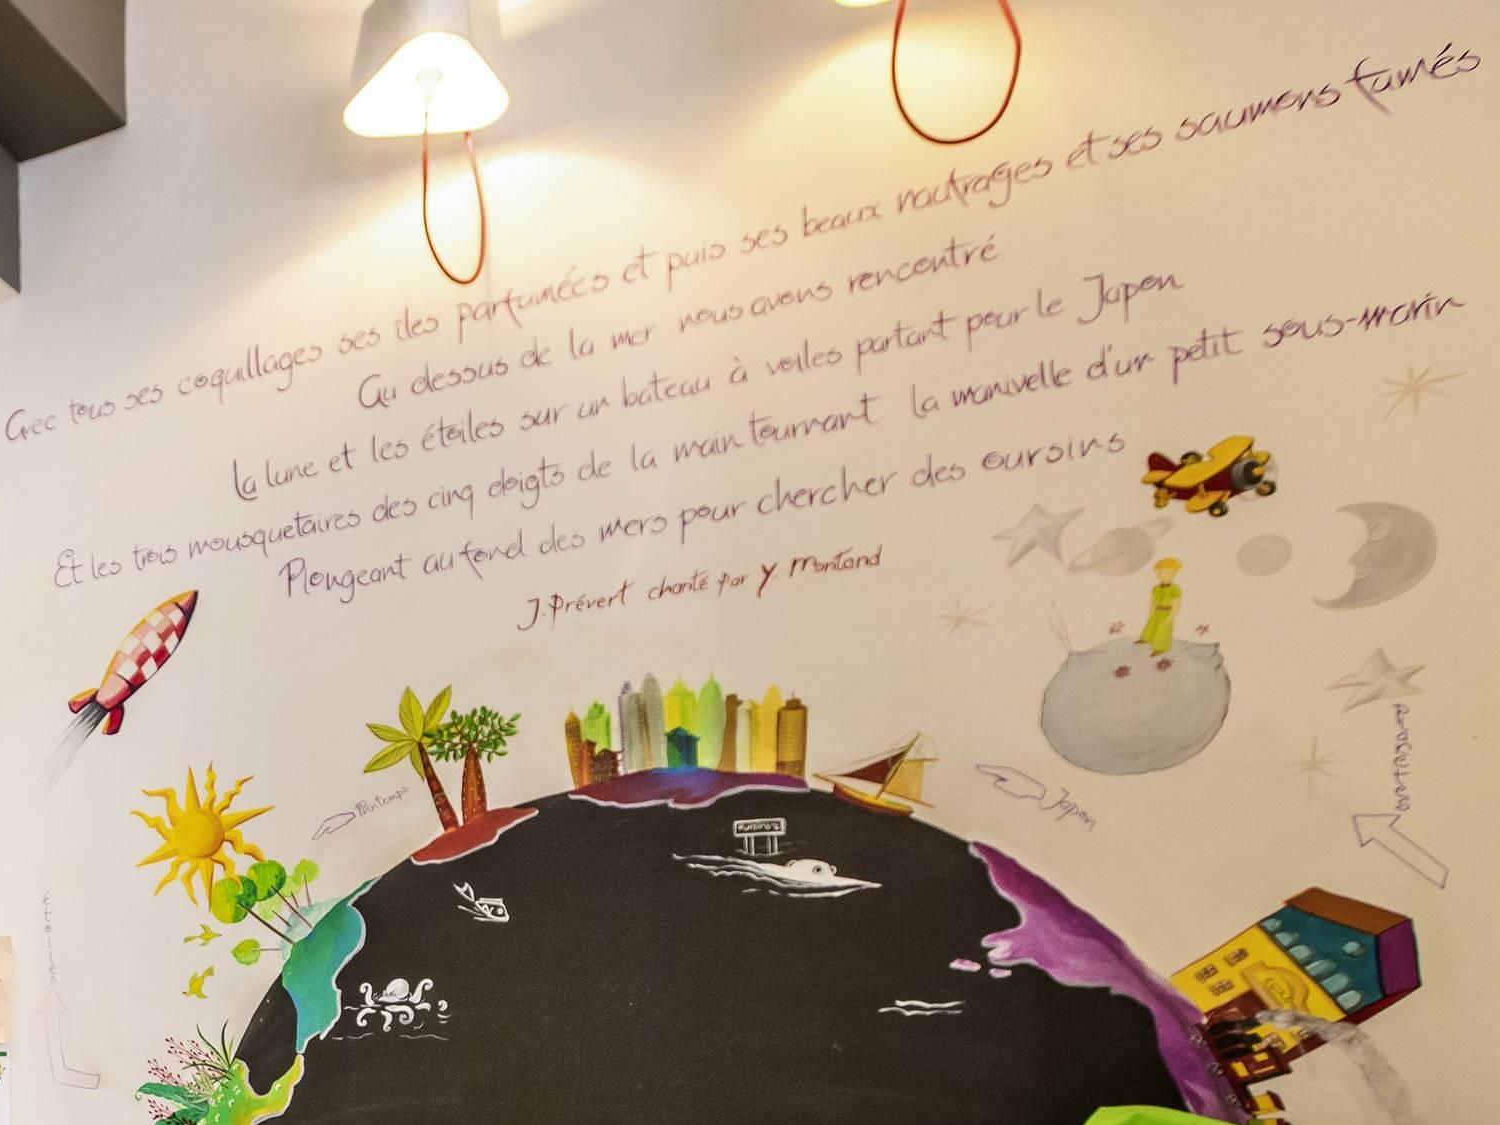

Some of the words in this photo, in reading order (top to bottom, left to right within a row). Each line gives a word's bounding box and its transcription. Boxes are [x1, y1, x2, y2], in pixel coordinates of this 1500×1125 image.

[68, 396, 116, 426] tous
[124, 384, 164, 412] ses
[177, 343, 323, 404] coquillages
[338, 327, 381, 355] ses
[622, 244, 658, 285] et
[666, 242, 727, 292] puis
[739, 223, 789, 256] ses
[802, 206, 882, 238] beaux
[1175, 82, 1341, 141] saumons
[1345, 41, 1482, 115] fumés
[409, 356, 509, 397] dessus
[520, 336, 553, 369] de
[568, 327, 596, 361] la
[611, 323, 657, 351] mer
[679, 303, 744, 336] nous
[749, 281, 833, 317] avons
[846, 233, 999, 293] rencontré
[52, 547, 85, 589] Et
[90, 551, 122, 581] les
[132, 538, 178, 567] trois
[188, 506, 362, 557] mousquetaires
[371, 492, 418, 525] des
[426, 481, 475, 521] cinq
[488, 457, 565, 510] doigts
[577, 446, 613, 483] de
[630, 442, 657, 474] la
[674, 432, 743, 463] main
[748, 391, 882, 448] tournant
[912, 383, 940, 418] la
[952, 358, 1073, 410] manivelle
[1169, 326, 1244, 386] petit
[265, 457, 319, 491] lune
[328, 441, 358, 475] et
[371, 429, 410, 464] les
[420, 407, 506, 454] étoiles
[519, 400, 566, 432] sur
[577, 395, 611, 421] un
[620, 373, 712, 410] bateau
[729, 357, 750, 387] à
[766, 338, 843, 378] voiles
[856, 309, 960, 376] partant
[965, 302, 1028, 353] pour
[1036, 288, 1064, 320] le
[1076, 272, 1185, 326] Japon
[278, 550, 412, 604] Plongeant
[423, 549, 455, 576] au
[451, 533, 528, 579] fond
[538, 521, 586, 556] des
[599, 515, 668, 544] mers
[678, 499, 748, 544] pour
[757, 466, 900, 518] chercher
[912, 453, 967, 488] des
[981, 429, 1127, 470] oursins
